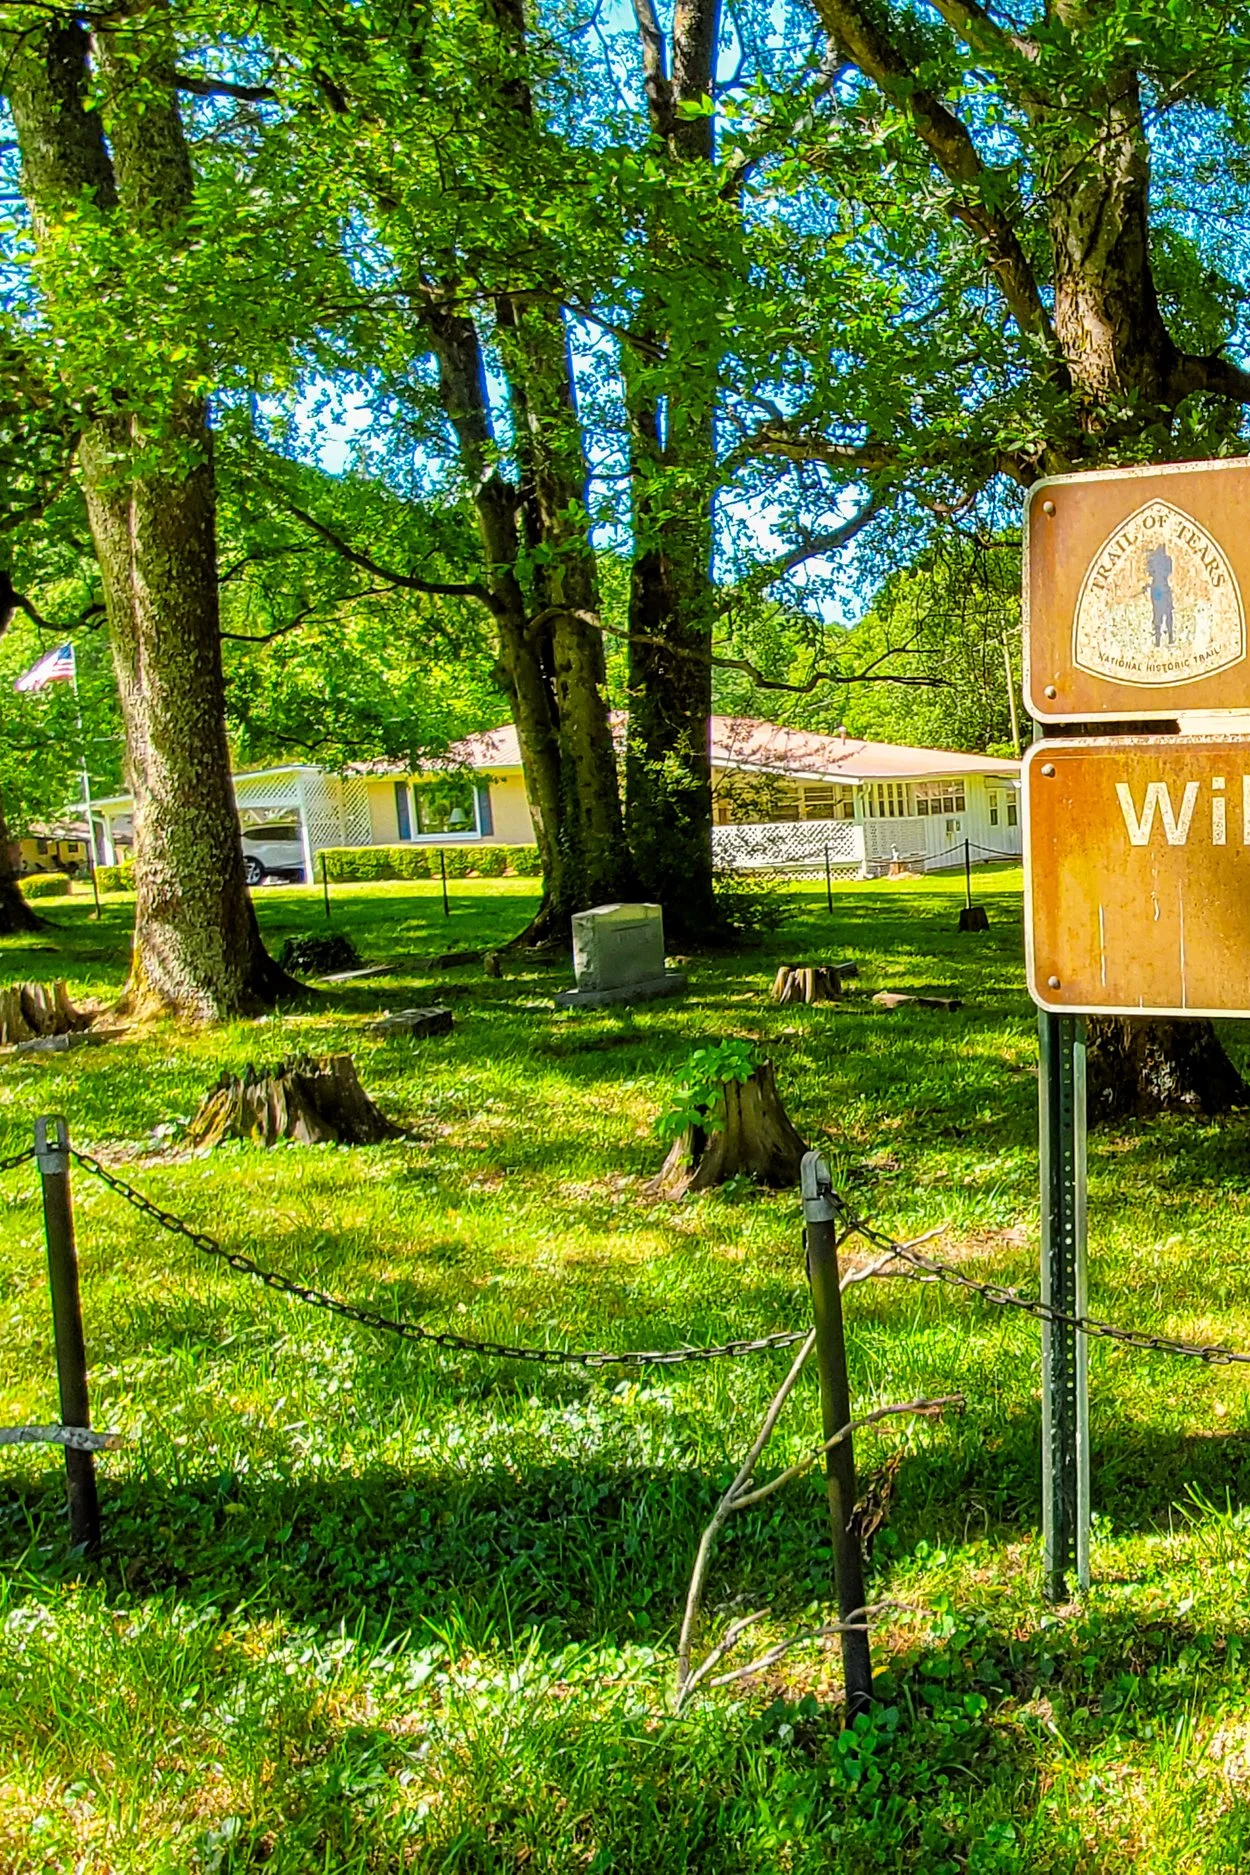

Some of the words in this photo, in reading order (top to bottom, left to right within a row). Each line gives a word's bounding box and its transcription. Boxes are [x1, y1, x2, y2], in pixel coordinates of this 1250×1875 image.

[1091, 532, 1138, 594] TRAIL
[1142, 515, 1170, 530] OF
[1176, 521, 1226, 588] TEARS
[1098, 652, 1142, 671] NATIONAL
[1146, 660, 1190, 673] HISTORIC
[1193, 646, 1221, 663] TRAIL
